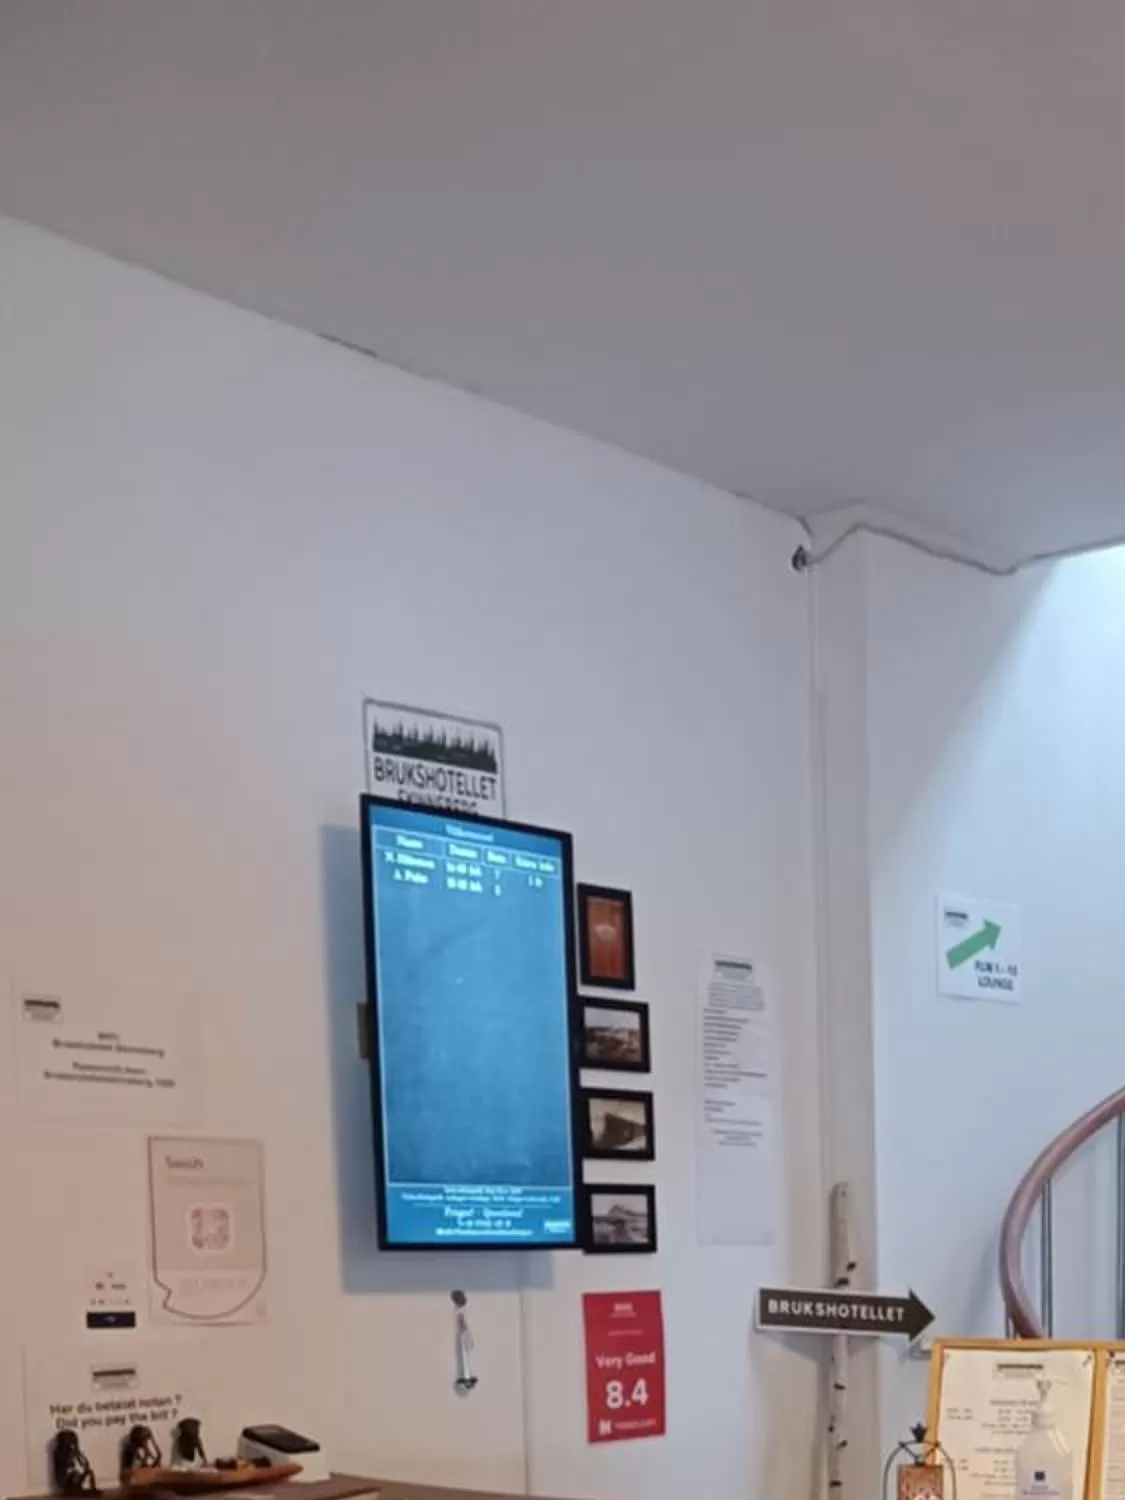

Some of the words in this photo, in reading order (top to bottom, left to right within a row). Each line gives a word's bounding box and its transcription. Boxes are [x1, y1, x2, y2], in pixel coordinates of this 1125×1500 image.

[374, 756, 497, 800] BRUKSHOTELLET
[977, 975, 1014, 991] LOUNGE
[768, 1298, 905, 1321] BRUKSHOTELLET
[596, 1353, 623, 1369] Very
[625, 1351, 656, 1366] Good
[605, 1376, 649, 1410] 8.4
